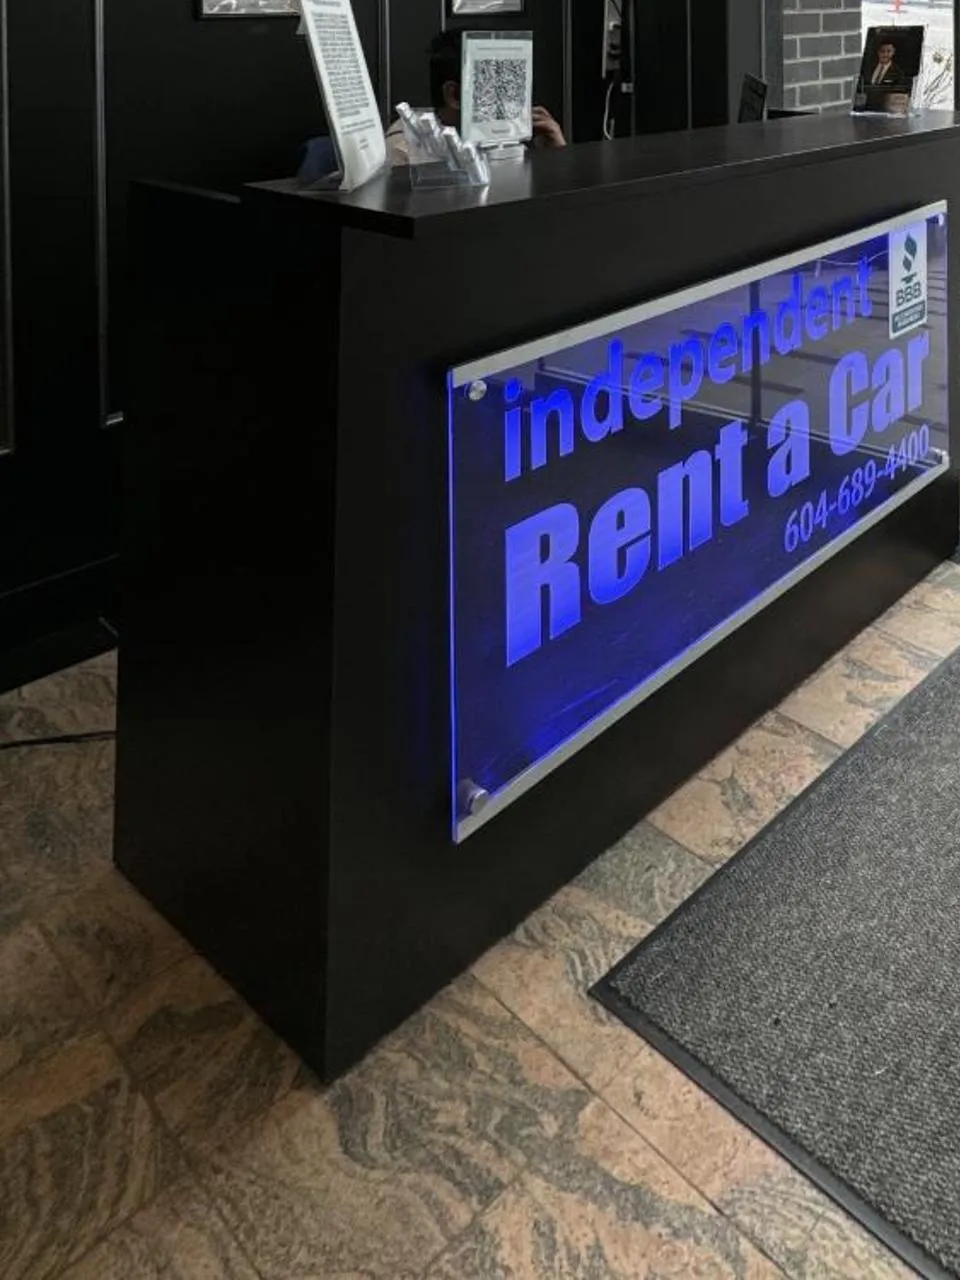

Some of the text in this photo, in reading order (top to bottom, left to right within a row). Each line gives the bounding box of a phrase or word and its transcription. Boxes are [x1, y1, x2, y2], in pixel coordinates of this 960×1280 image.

[504, 255, 874, 483] independent
[895, 282, 921, 307] BBB
[505, 333, 930, 668] Rent a Car
[784, 423, 930, 553] 604-689-4400
